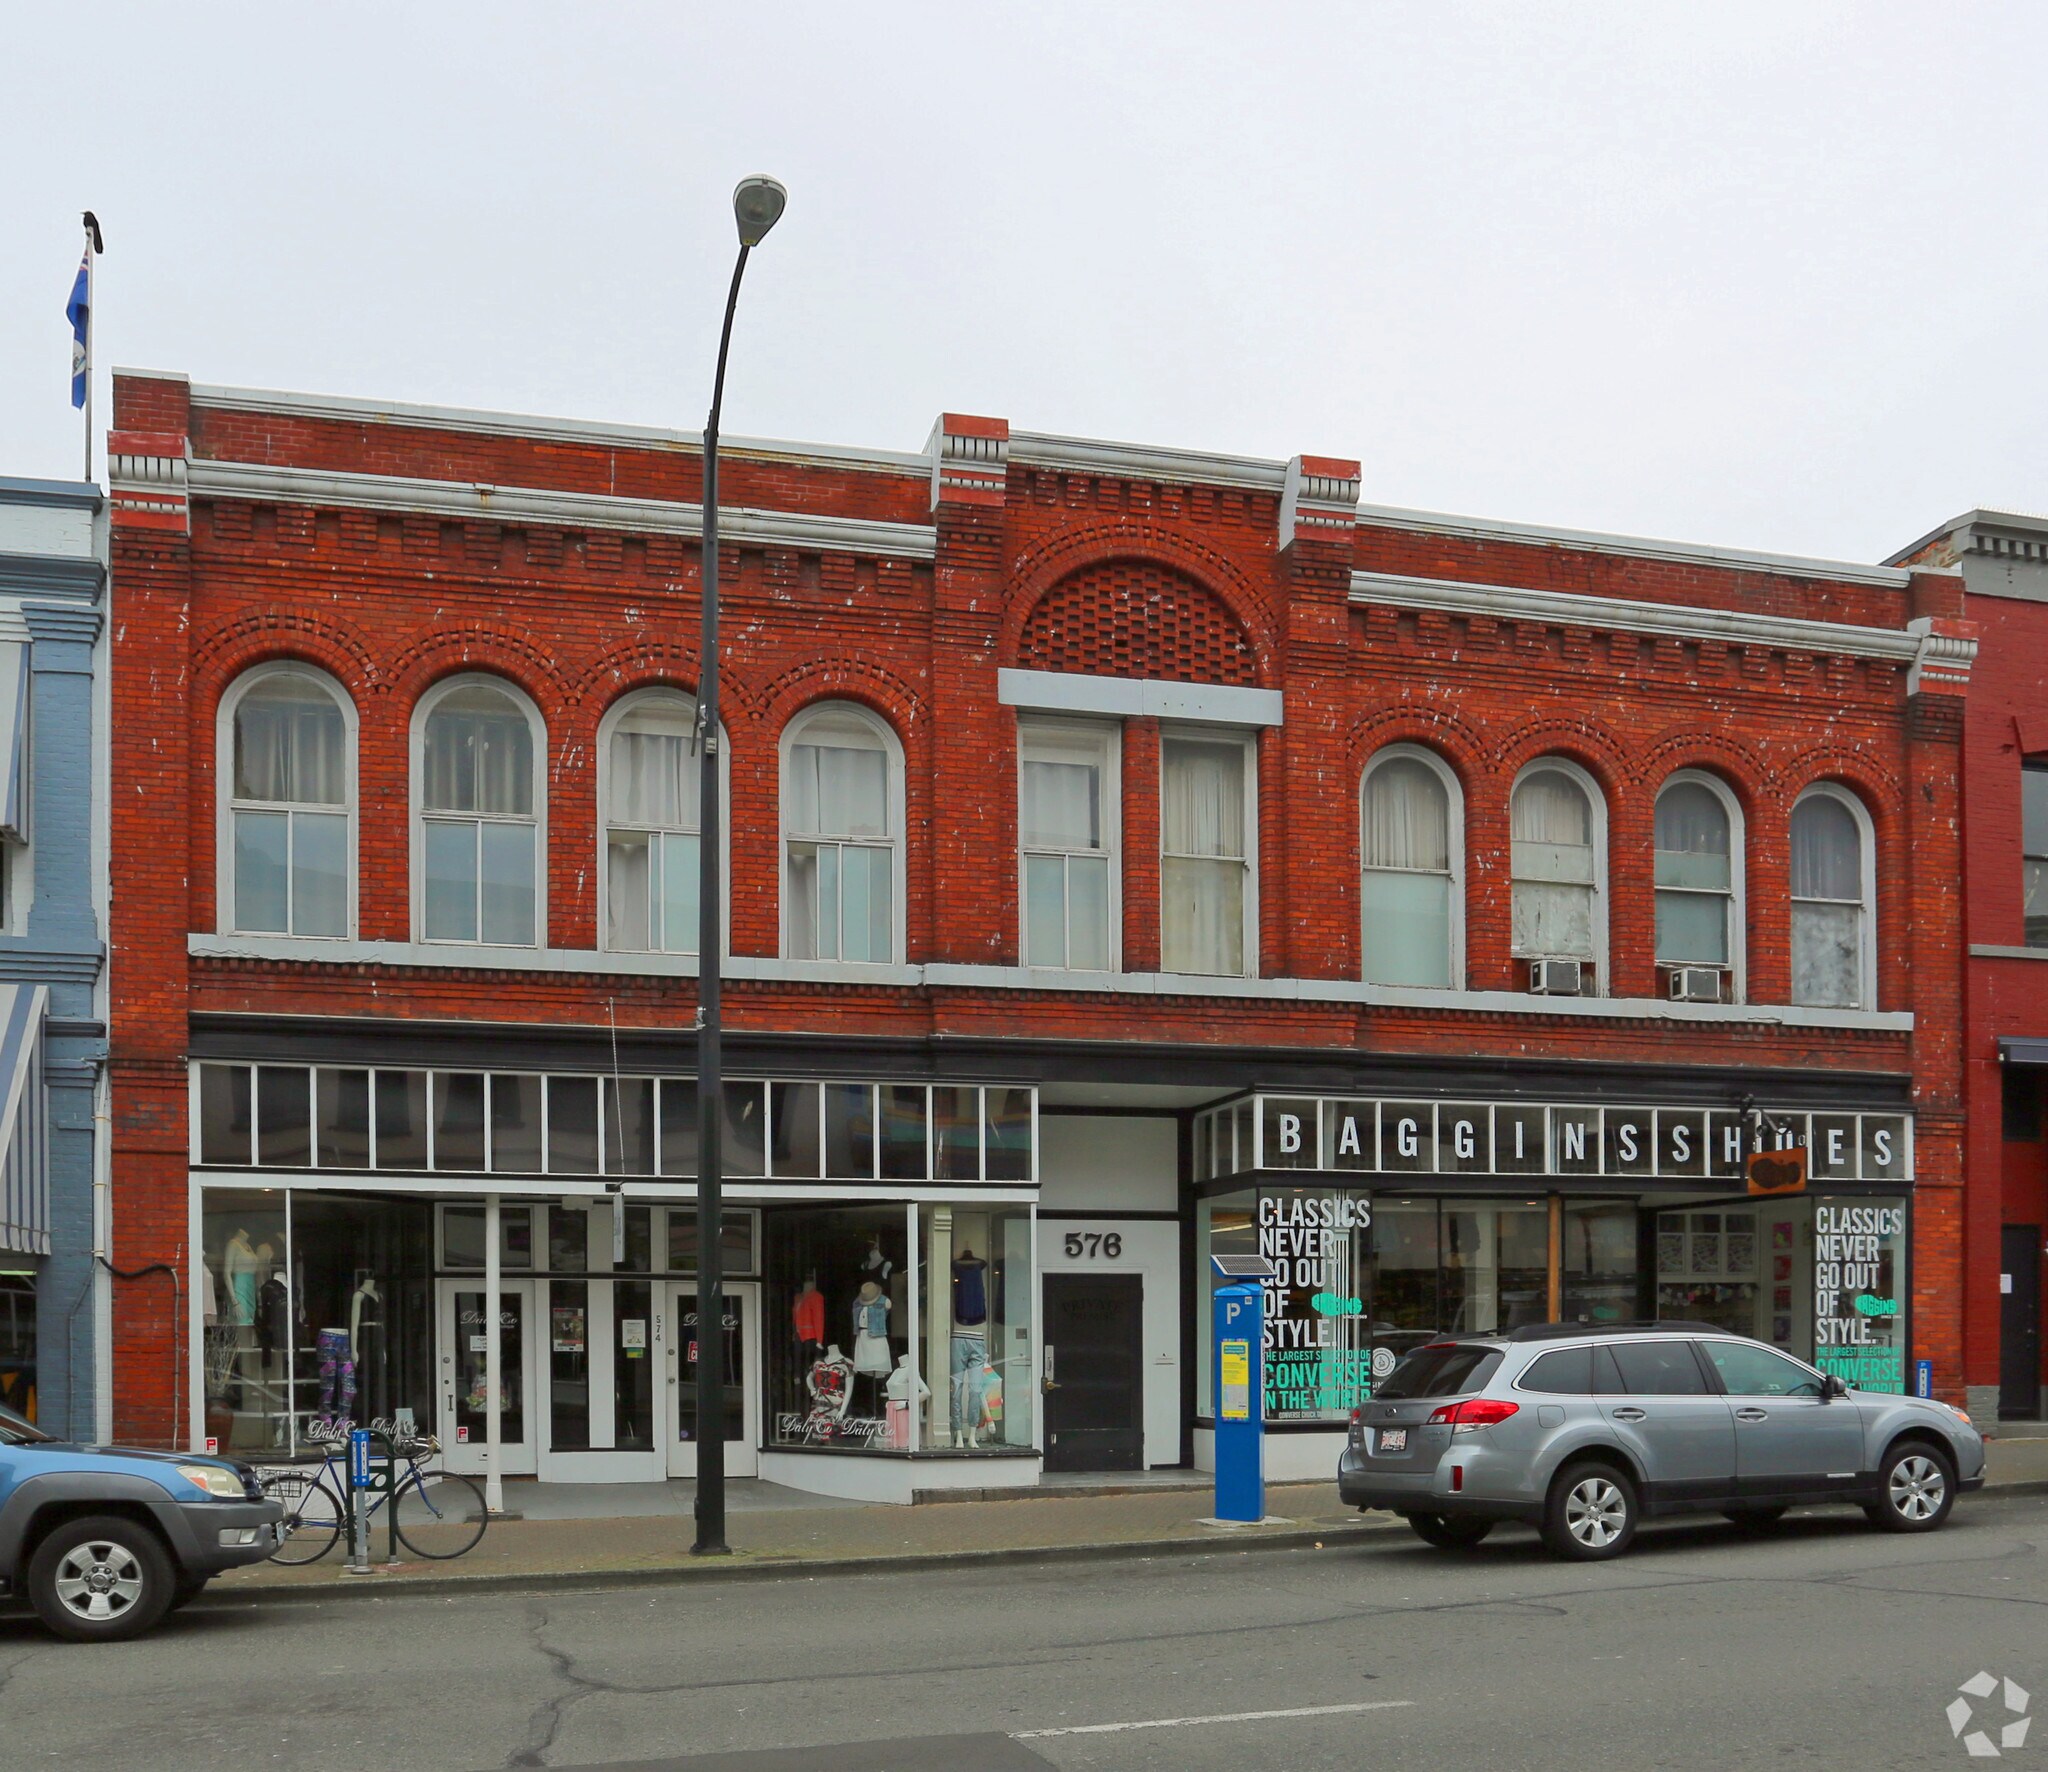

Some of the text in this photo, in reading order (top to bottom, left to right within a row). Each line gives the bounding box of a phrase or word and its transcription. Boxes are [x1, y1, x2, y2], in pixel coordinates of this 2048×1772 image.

[1280, 1114, 1638, 1161] BAGGINS
[1260, 1197, 1370, 1228] CLASSICS
[1816, 1207, 1902, 1235] CLASSICS
[1065, 1232, 1122, 1258] 576
[1260, 1228, 1335, 1257] NEVER
[1816, 1235, 1880, 1261] NEVER
[1296, 1258, 1340, 1287] OUT
[1816, 1262, 1879, 1289] GO OUT
[1227, 1303, 1240, 1325] P
[1264, 1289, 1290, 1319] OF
[1816, 1290, 1840, 1317] OF
[1264, 1319, 1337, 1348] STYLE.
[1816, 1318, 1876, 1345] STYLE.
[1279, 1350, 1314, 1362] LARGEST
[1360, 1349, 1371, 1360] OF
[1816, 1347, 1828, 1356] THE
[1830, 1347, 1857, 1357] LARGEST
[1265, 1361, 1371, 1389] CONVERSE
[1816, 1358, 1902, 1381] CONVERSE
[1279, 1390, 1311, 1410] THE
[781, 1415, 832, 1444] Daly Co
[841, 1416, 895, 1448] Daly Co
